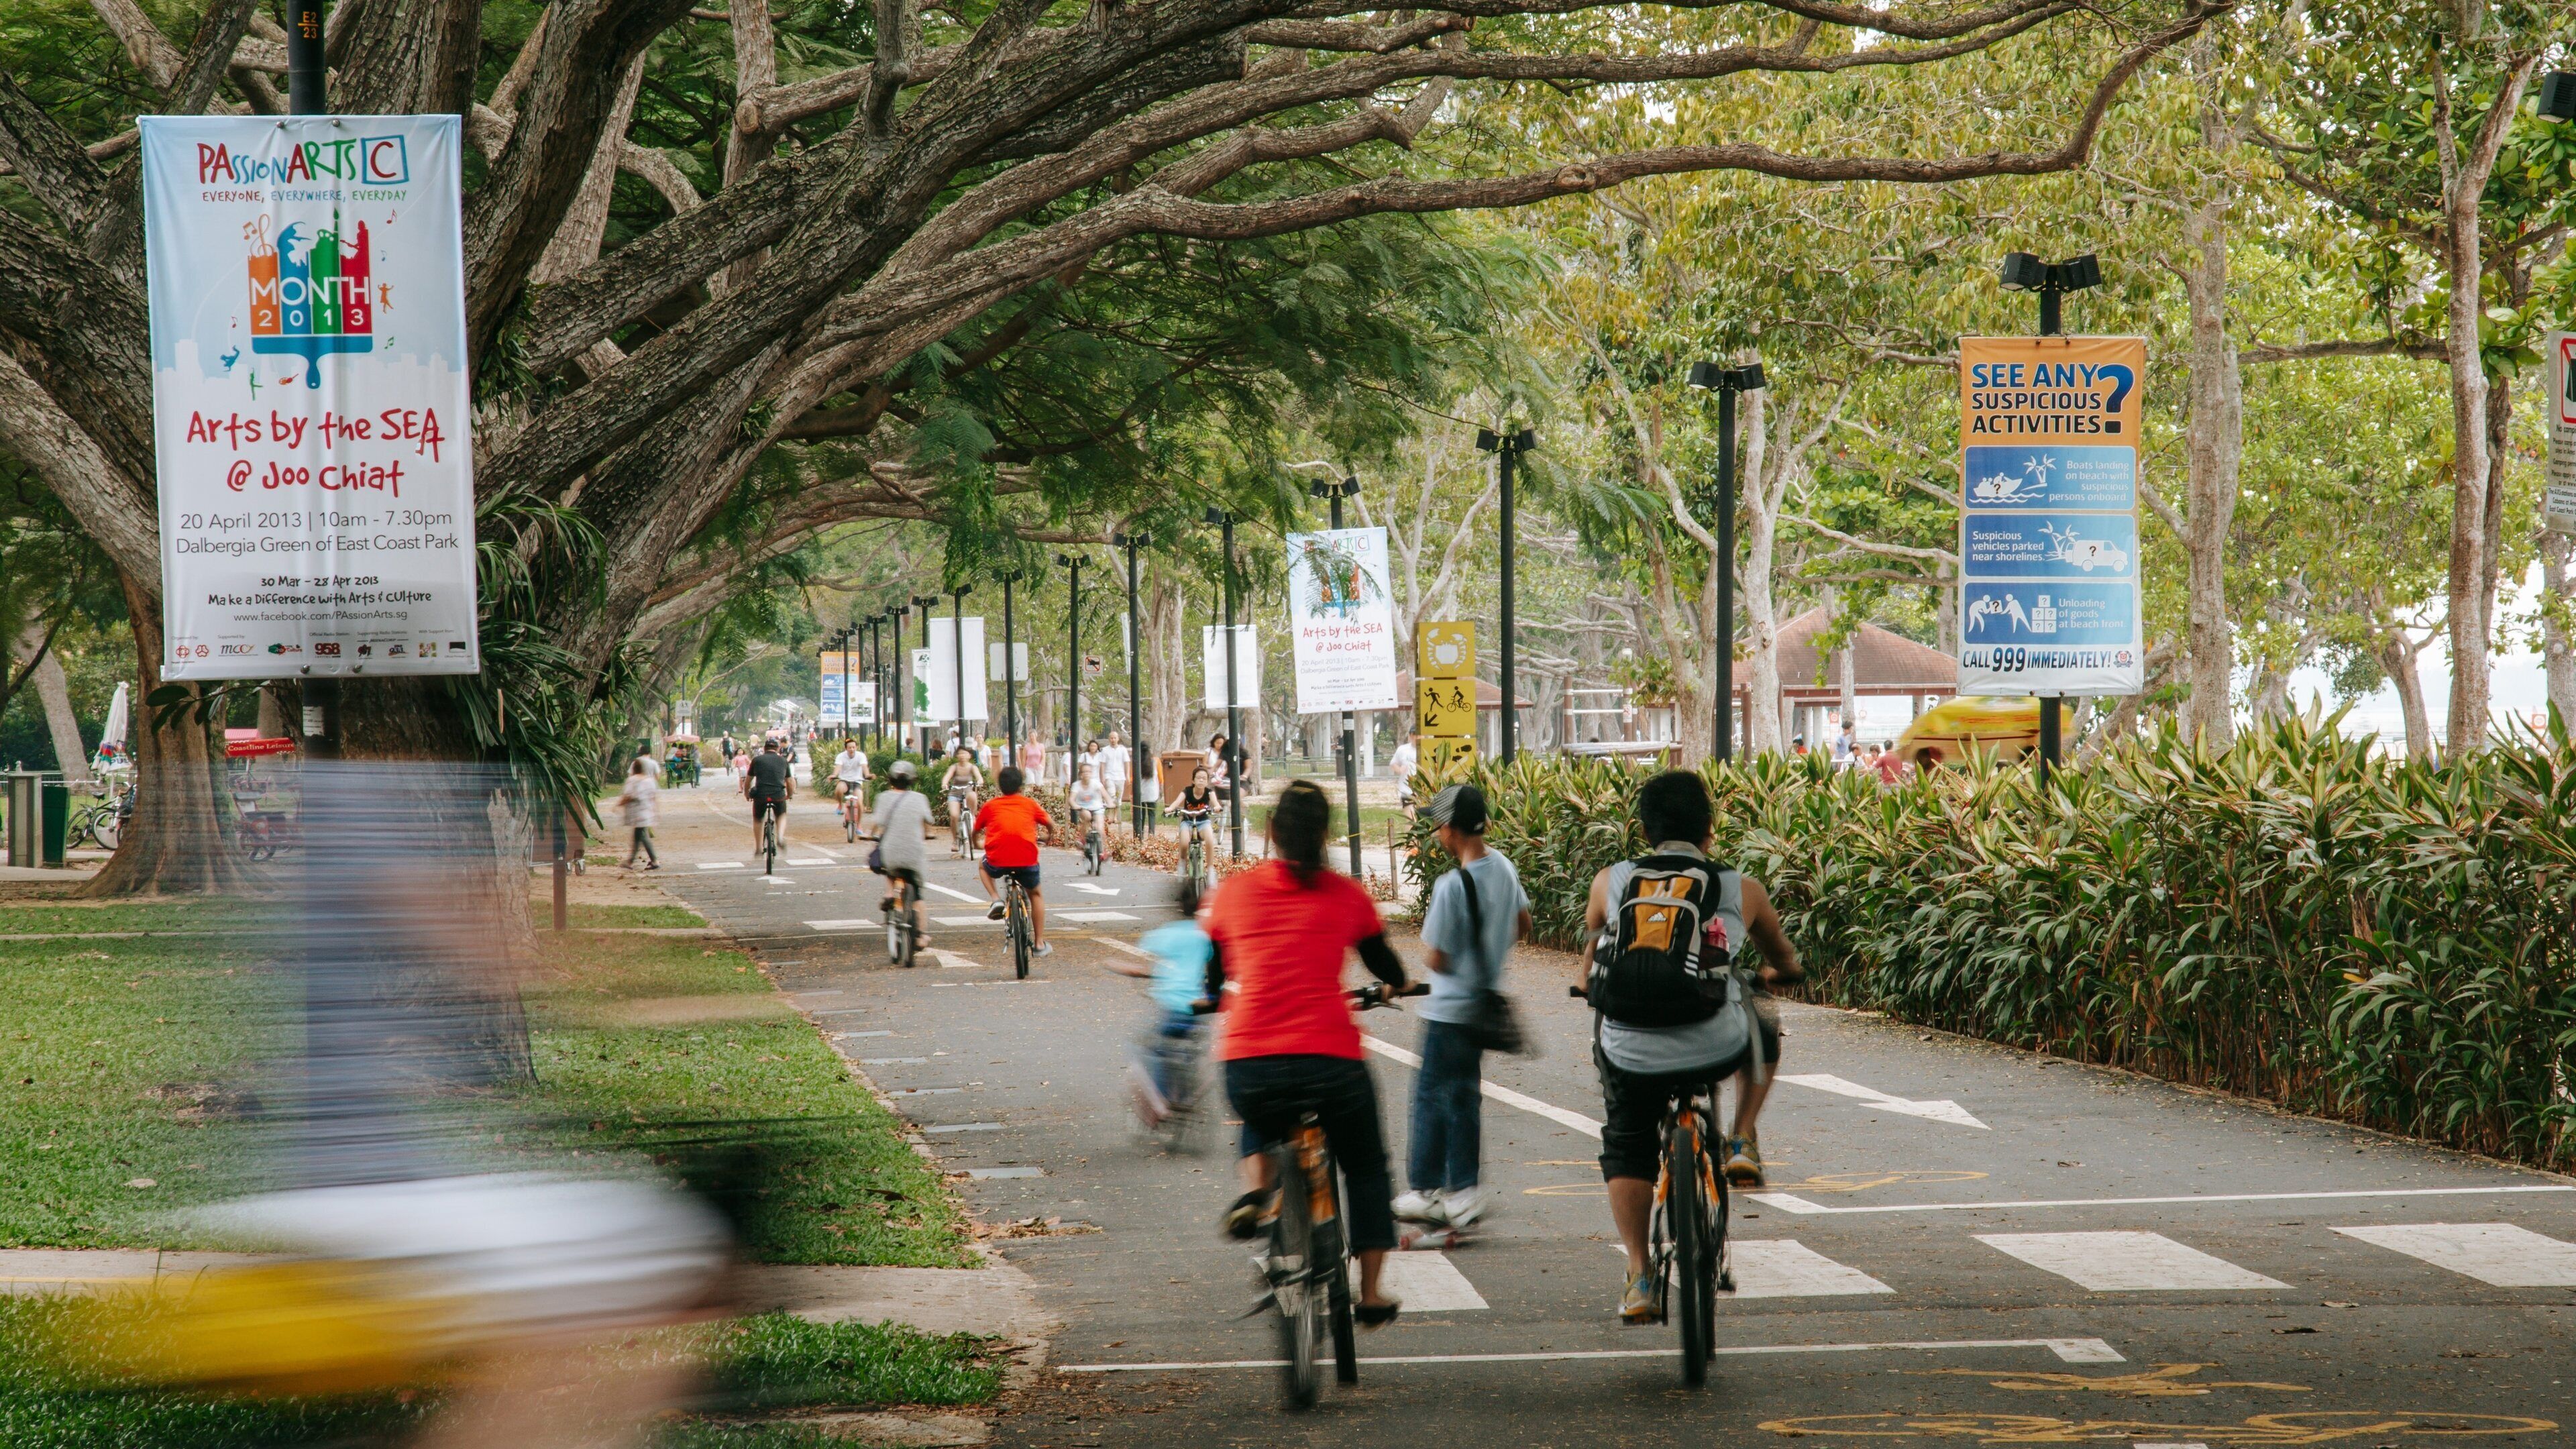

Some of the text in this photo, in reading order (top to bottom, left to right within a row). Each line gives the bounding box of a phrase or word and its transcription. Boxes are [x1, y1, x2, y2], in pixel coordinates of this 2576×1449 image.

[303, 11, 317, 23] E2
[303, 27, 317, 38] 23
[203, 189, 407, 203] EVERYONE, EVERYWHERE, EVERYDAY
[251, 276, 370, 306] MONTH
[1972, 364, 2025, 388] SEE
[2033, 364, 2099, 388] ANY
[1972, 392, 2101, 410] SUSPICIOUS
[1972, 415, 2100, 433] ACTIVITIES
[2557, 424, 2576, 435] No camp
[187, 408, 445, 462] Arts by the SEA
[2067, 460, 2129, 471] Boats landing
[227, 460, 405, 498] @ Joo Chiat
[2080, 472, 2107, 480] beach
[2108, 472, 2129, 480] with
[2082, 483, 2129, 492] suspicious
[2049, 494, 2085, 502] persons
[180, 513, 203, 529] 20
[209, 512, 251, 533] April
[258, 512, 302, 528] 2013
[319, 511, 366, 527] 10am
[385, 510, 452, 529] 7.30pm
[1972, 531, 2022, 542] Suspicious
[176, 533, 458, 557] Dalbergia Green of East Coast Park
[1972, 542, 2044, 552] vehicles parked
[1996, 553, 2045, 561] shorelines.
[261, 578, 274, 587] 30
[278, 576, 301, 588] Mar
[314, 577, 329, 587] 28
[333, 576, 352, 588] Apr
[355, 575, 379, 586] 2013
[208, 593, 243, 606] Make
[246, 596, 252, 604] a
[255, 592, 315, 605] Difference
[318, 592, 346, 607] with
[349, 592, 375, 604] Arts
[2059, 599, 2105, 608] Unloading
[233, 609, 407, 622] www.facebook.com/PAssionArts.sg
[2071, 610, 2099, 620] goods
[1303, 622, 1383, 639] Arts by the SEA
[2071, 620, 2099, 628] beach
[315, 643, 341, 655] 958
[1316, 639, 1372, 653] @ Joo Chiat
[1963, 647, 2112, 672] CALL 999 IMMEDIATELY!
